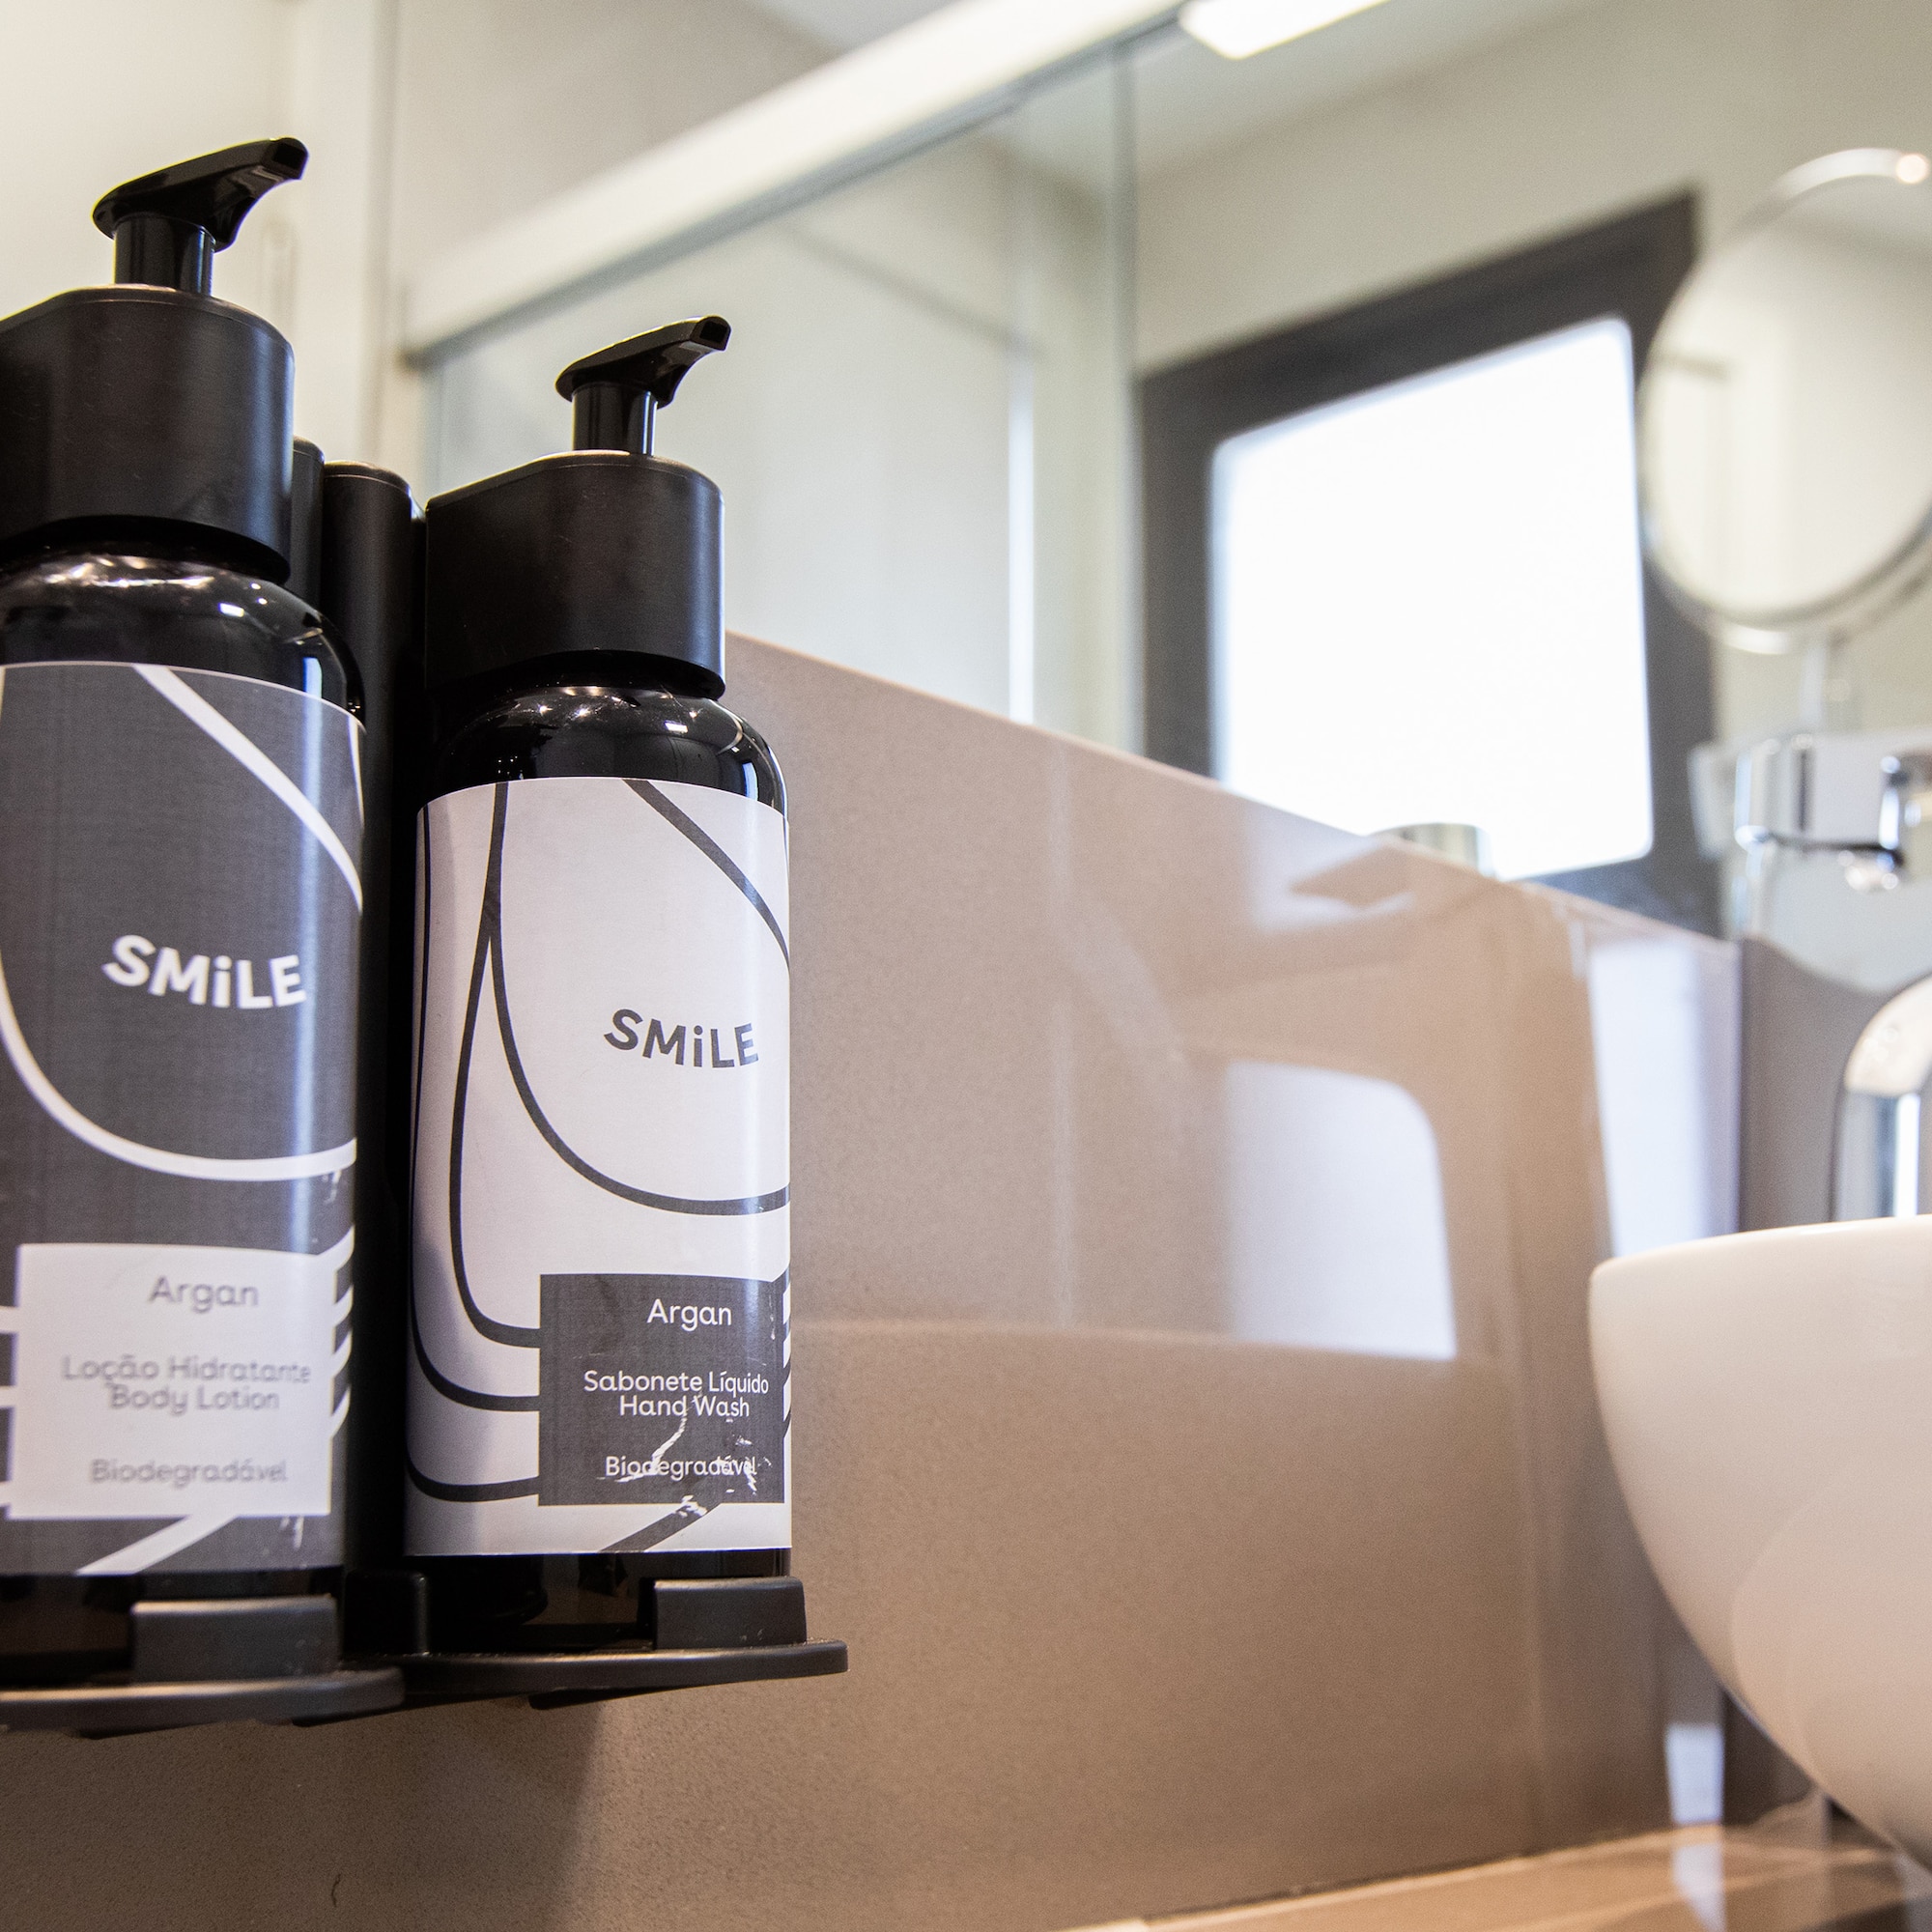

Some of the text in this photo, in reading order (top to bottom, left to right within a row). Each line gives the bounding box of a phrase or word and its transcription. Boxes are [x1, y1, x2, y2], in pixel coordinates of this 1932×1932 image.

[148, 1275, 260, 1314] Argan
[646, 1298, 732, 1332] Argan
[62, 1354, 312, 1387] Loção Hidratante
[583, 1370, 770, 1398] Sabonete Líquido
[108, 1385, 281, 1416] Body Lotion
[619, 1394, 751, 1417] Hand Wash
[90, 1458, 288, 1489] Biodegradável
